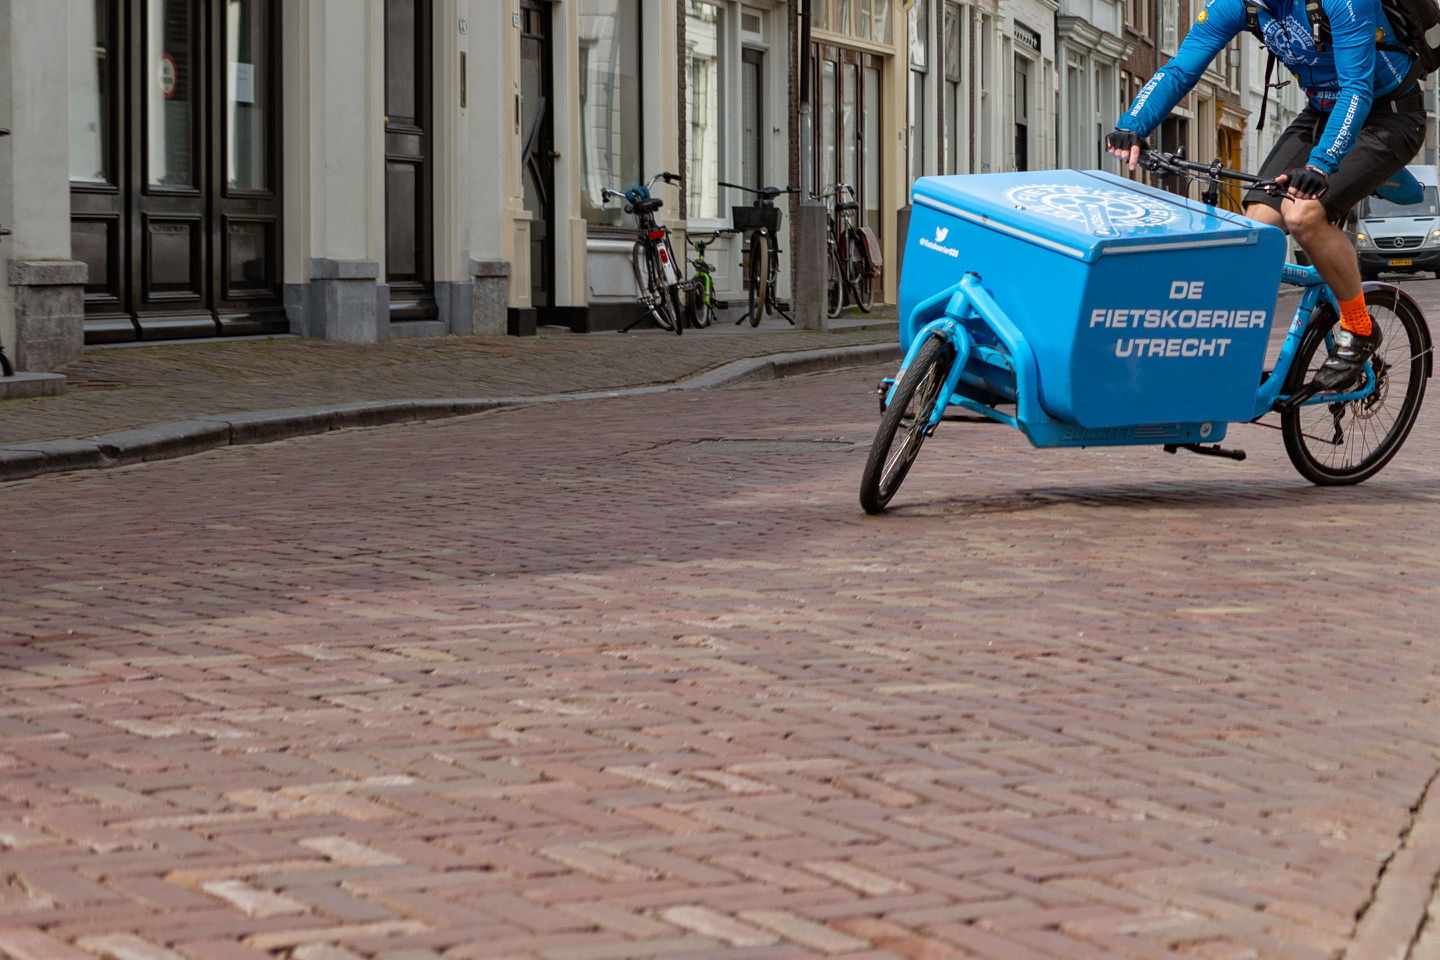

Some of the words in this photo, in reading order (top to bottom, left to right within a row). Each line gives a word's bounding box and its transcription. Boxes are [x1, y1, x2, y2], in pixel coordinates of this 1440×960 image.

[1169, 281, 1204, 299] DE
[1089, 309, 1267, 328] FIETSKOERIER
[1115, 338, 1231, 357] UTRECHT
